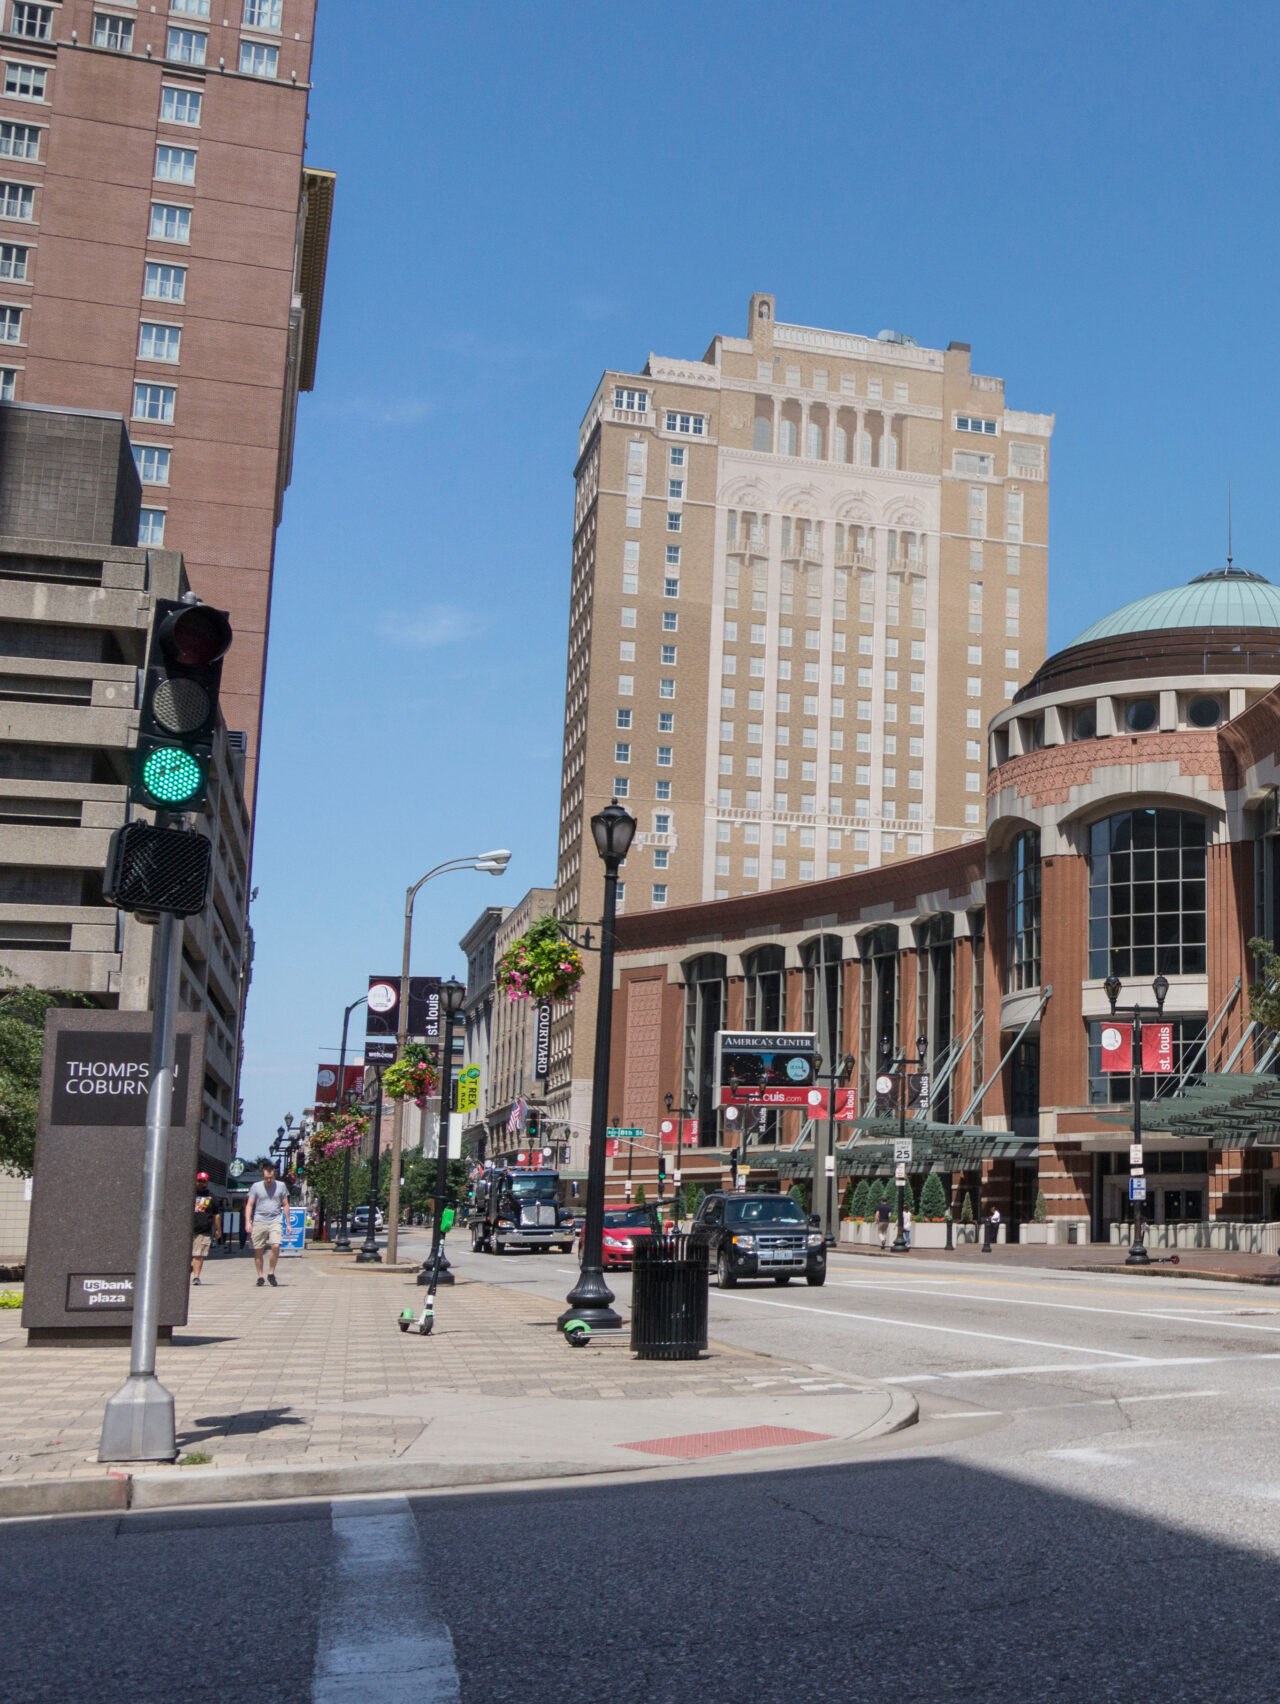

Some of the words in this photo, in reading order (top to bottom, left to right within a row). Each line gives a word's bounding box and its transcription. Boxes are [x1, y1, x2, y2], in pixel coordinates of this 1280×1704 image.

[425, 993, 439, 1021] louis
[427, 1022, 438, 1036] st.
[538, 1005, 550, 1074] COURTYARD
[724, 1037, 774, 1047] AMERICA'S
[776, 1037, 812, 1047] CENTER
[1158, 1026, 1170, 1054] louis
[66, 1061, 179, 1079] THOMPS
[1159, 1056, 1171, 1071] st.
[919, 1075, 929, 1097] louis
[896, 1150, 911, 1159] 25
[89, 1293, 126, 1305] plaza
